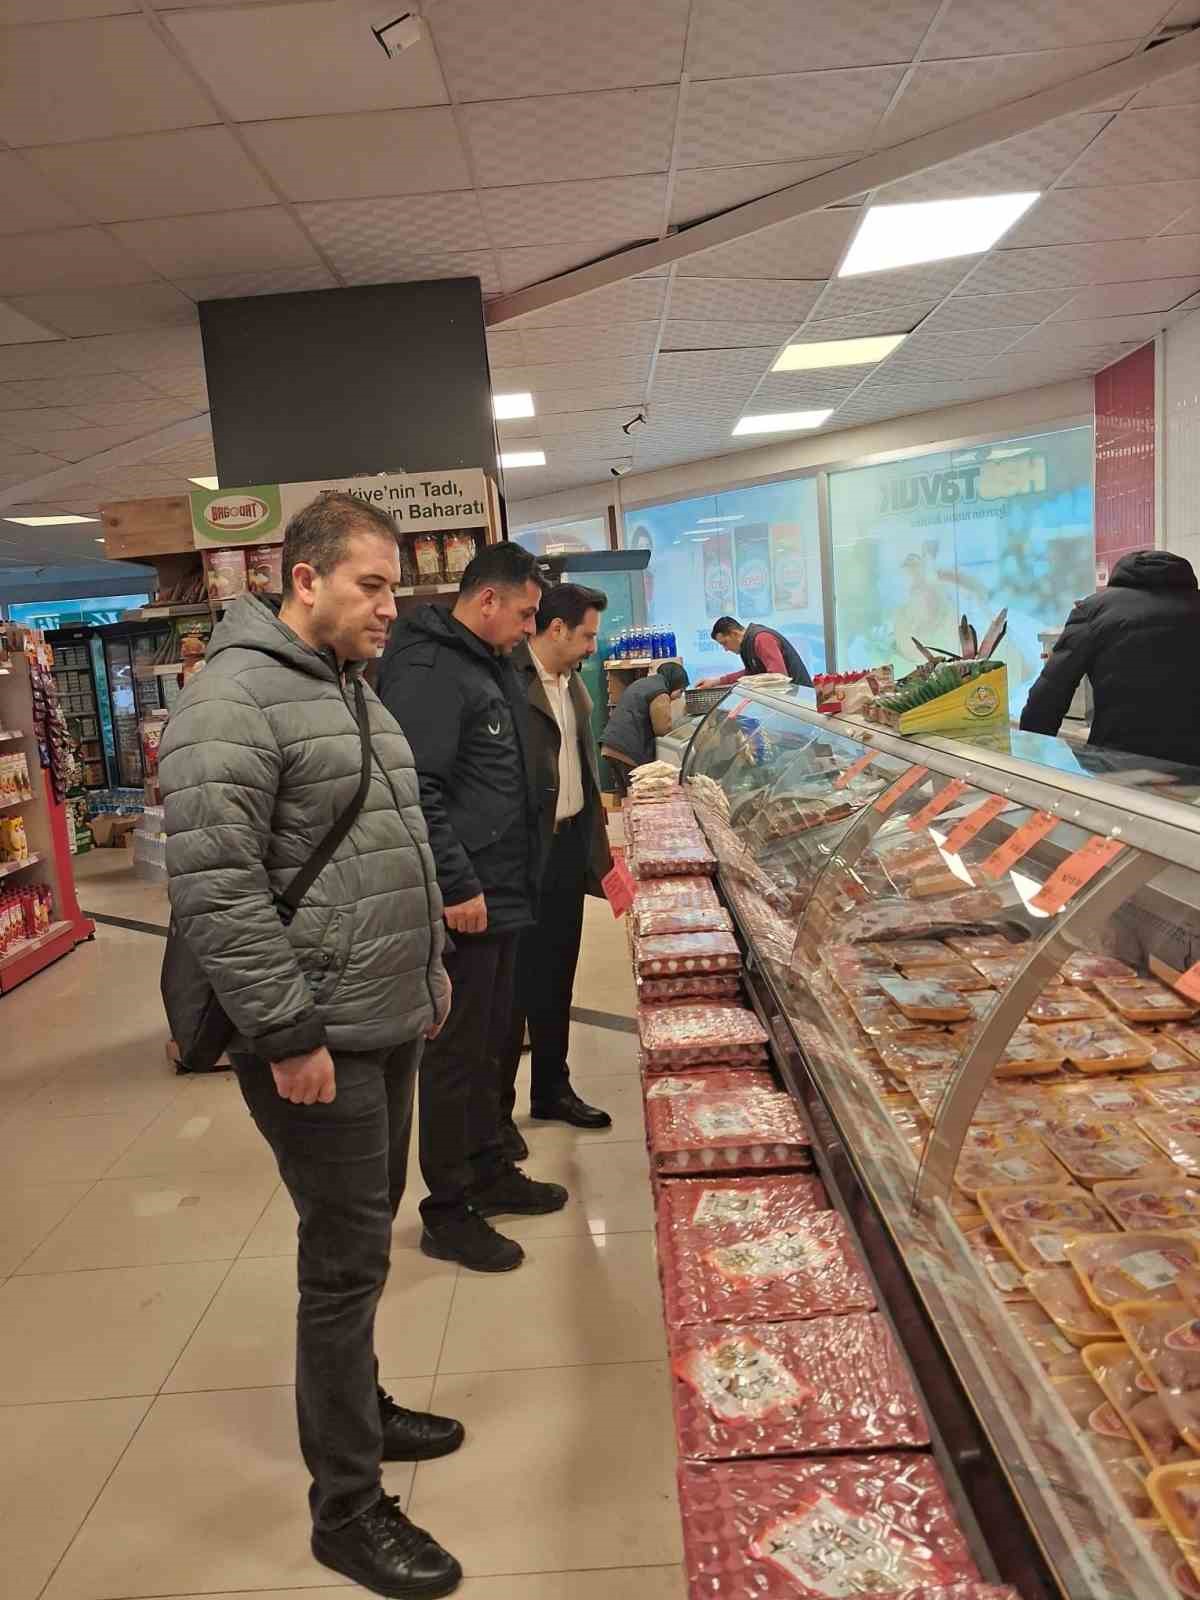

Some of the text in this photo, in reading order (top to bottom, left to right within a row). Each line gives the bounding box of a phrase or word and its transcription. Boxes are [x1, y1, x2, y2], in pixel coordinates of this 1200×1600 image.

[320, 480, 463, 504] kiye'nin Tadı,
[409, 500, 484, 519] Baharatı
